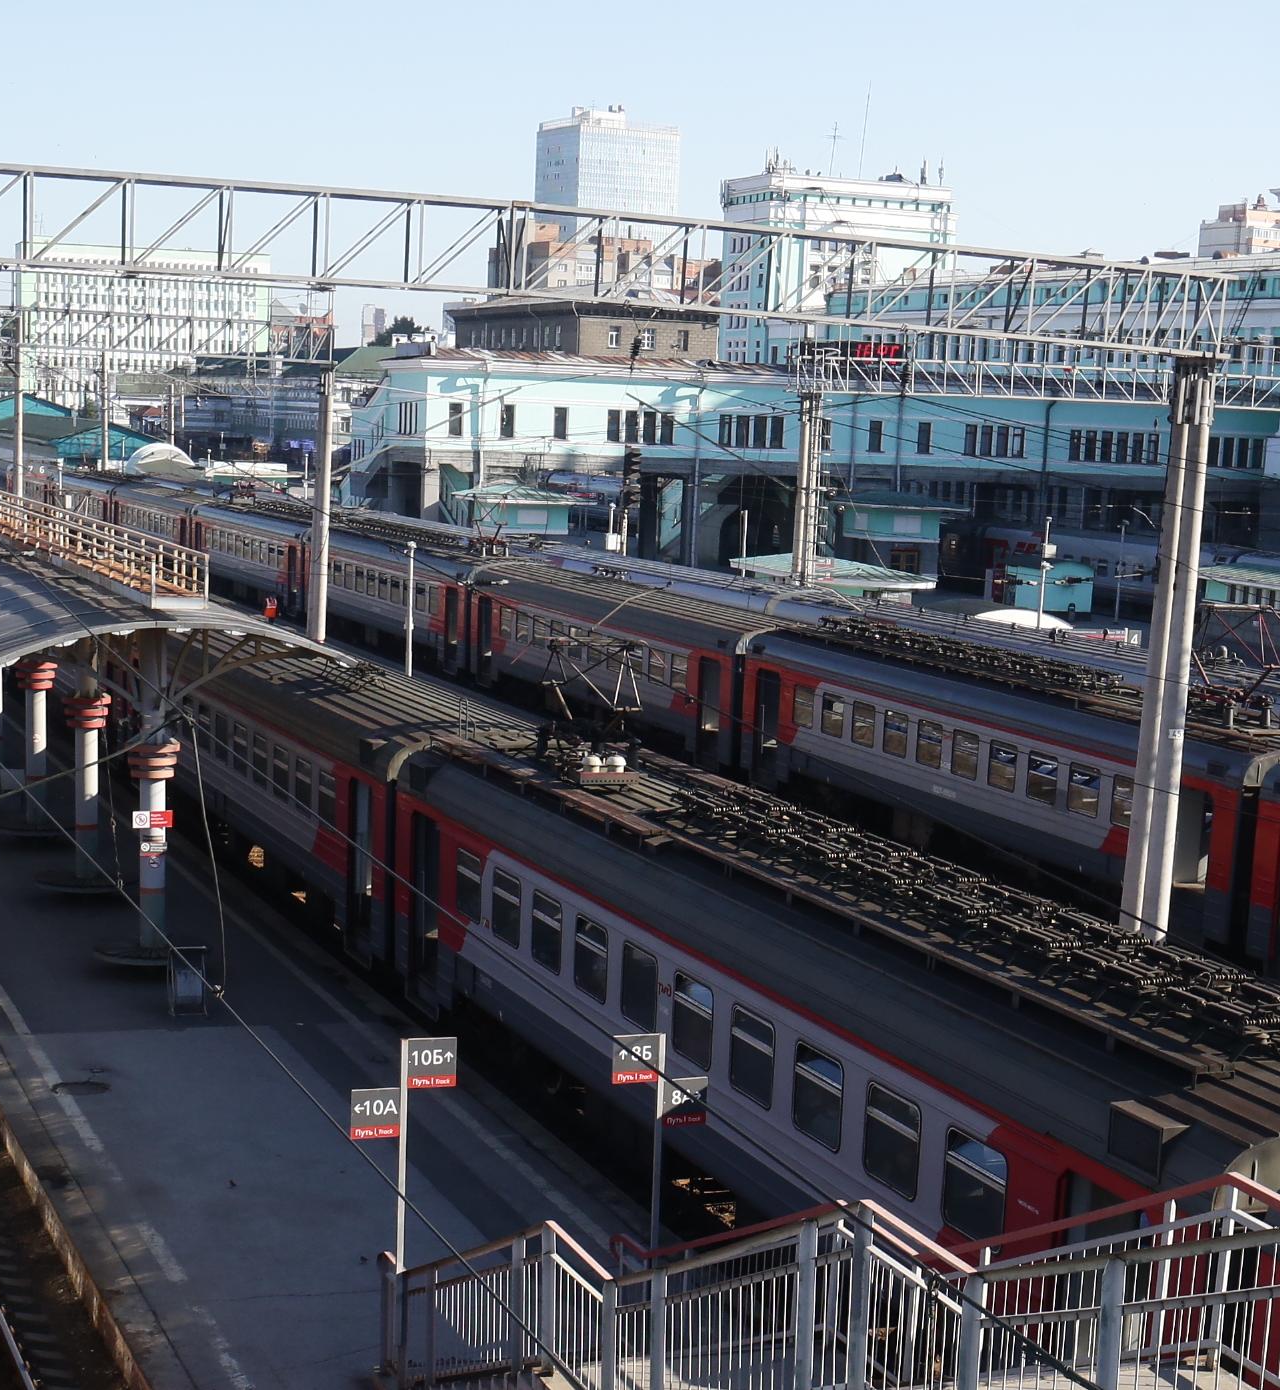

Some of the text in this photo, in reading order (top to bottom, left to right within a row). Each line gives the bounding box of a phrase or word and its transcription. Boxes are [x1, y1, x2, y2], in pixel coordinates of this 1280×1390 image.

[39, 465, 45, 474] 6
[1130, 633, 1138, 645] 4
[411, 1049, 444, 1066] 10Б
[631, 1044, 652, 1061] 8Б
[412, 1078, 430, 1086] Путь
[617, 1073, 634, 1082] Путь
[671, 1088, 694, 1105] 8А
[363, 1098, 398, 1116] 10А
[355, 1128, 373, 1138] Путь
